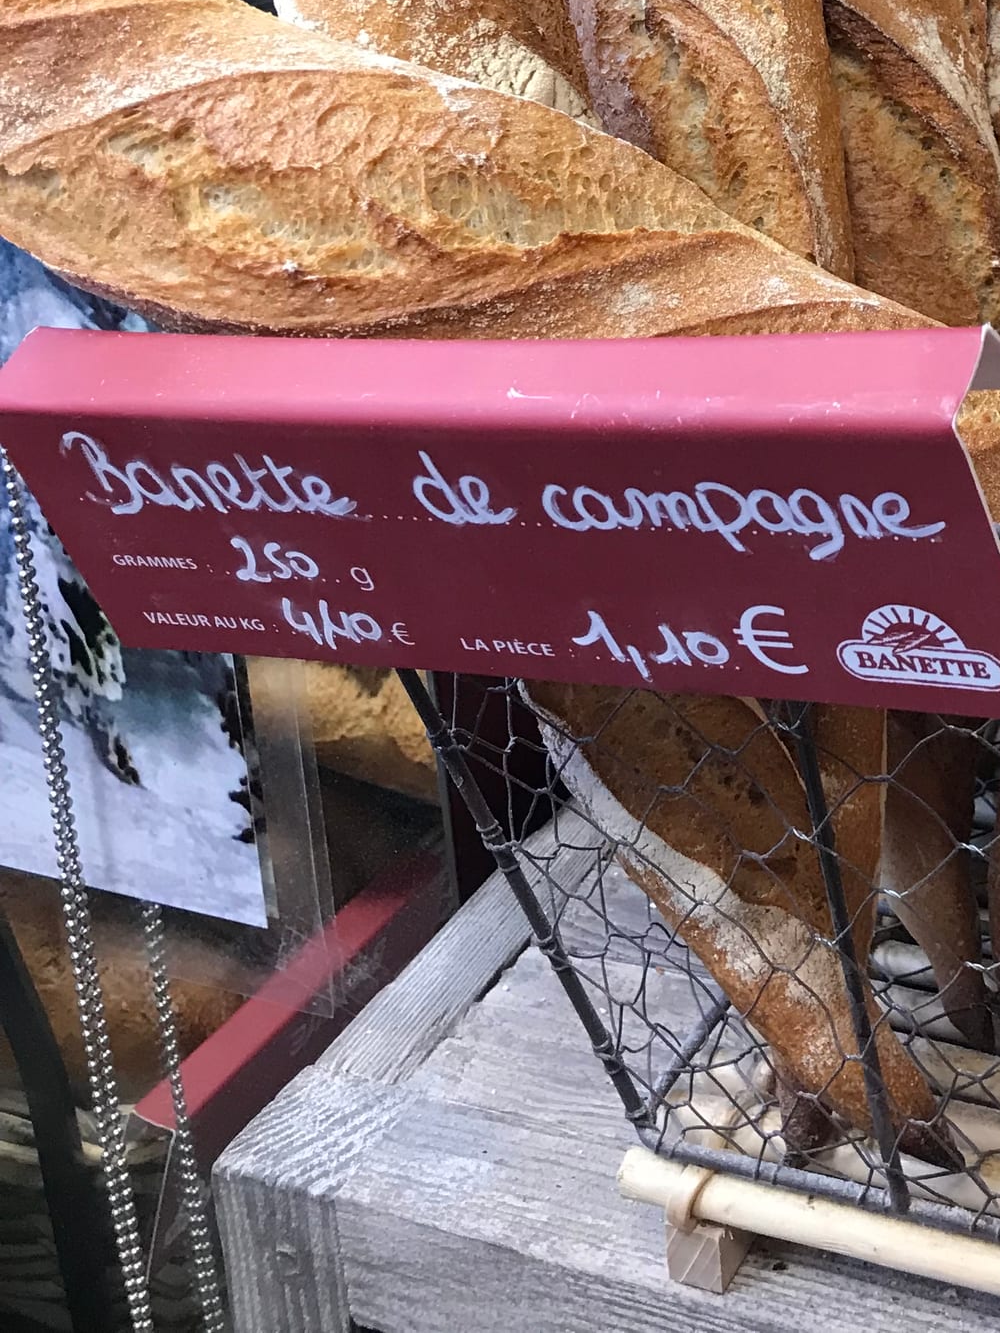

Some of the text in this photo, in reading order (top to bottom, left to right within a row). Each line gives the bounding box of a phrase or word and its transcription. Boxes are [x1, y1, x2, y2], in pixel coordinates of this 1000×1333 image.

[62, 431, 946, 561] Banette de campagne
[112, 554, 198, 570] GRAMMES
[230, 535, 320, 583] 250
[350, 566, 375, 591] g
[143, 611, 212, 628] VALEUR
[213, 615, 238, 630] AU
[240, 616, 266, 632] KG
[391, 622, 416, 645] €
[460, 637, 490, 653] LA
[491, 638, 556, 657] PIÈCE
[572, 610, 731, 682] 1,10
[733, 604, 809, 675] €
[853, 650, 992, 680] BANETTE
